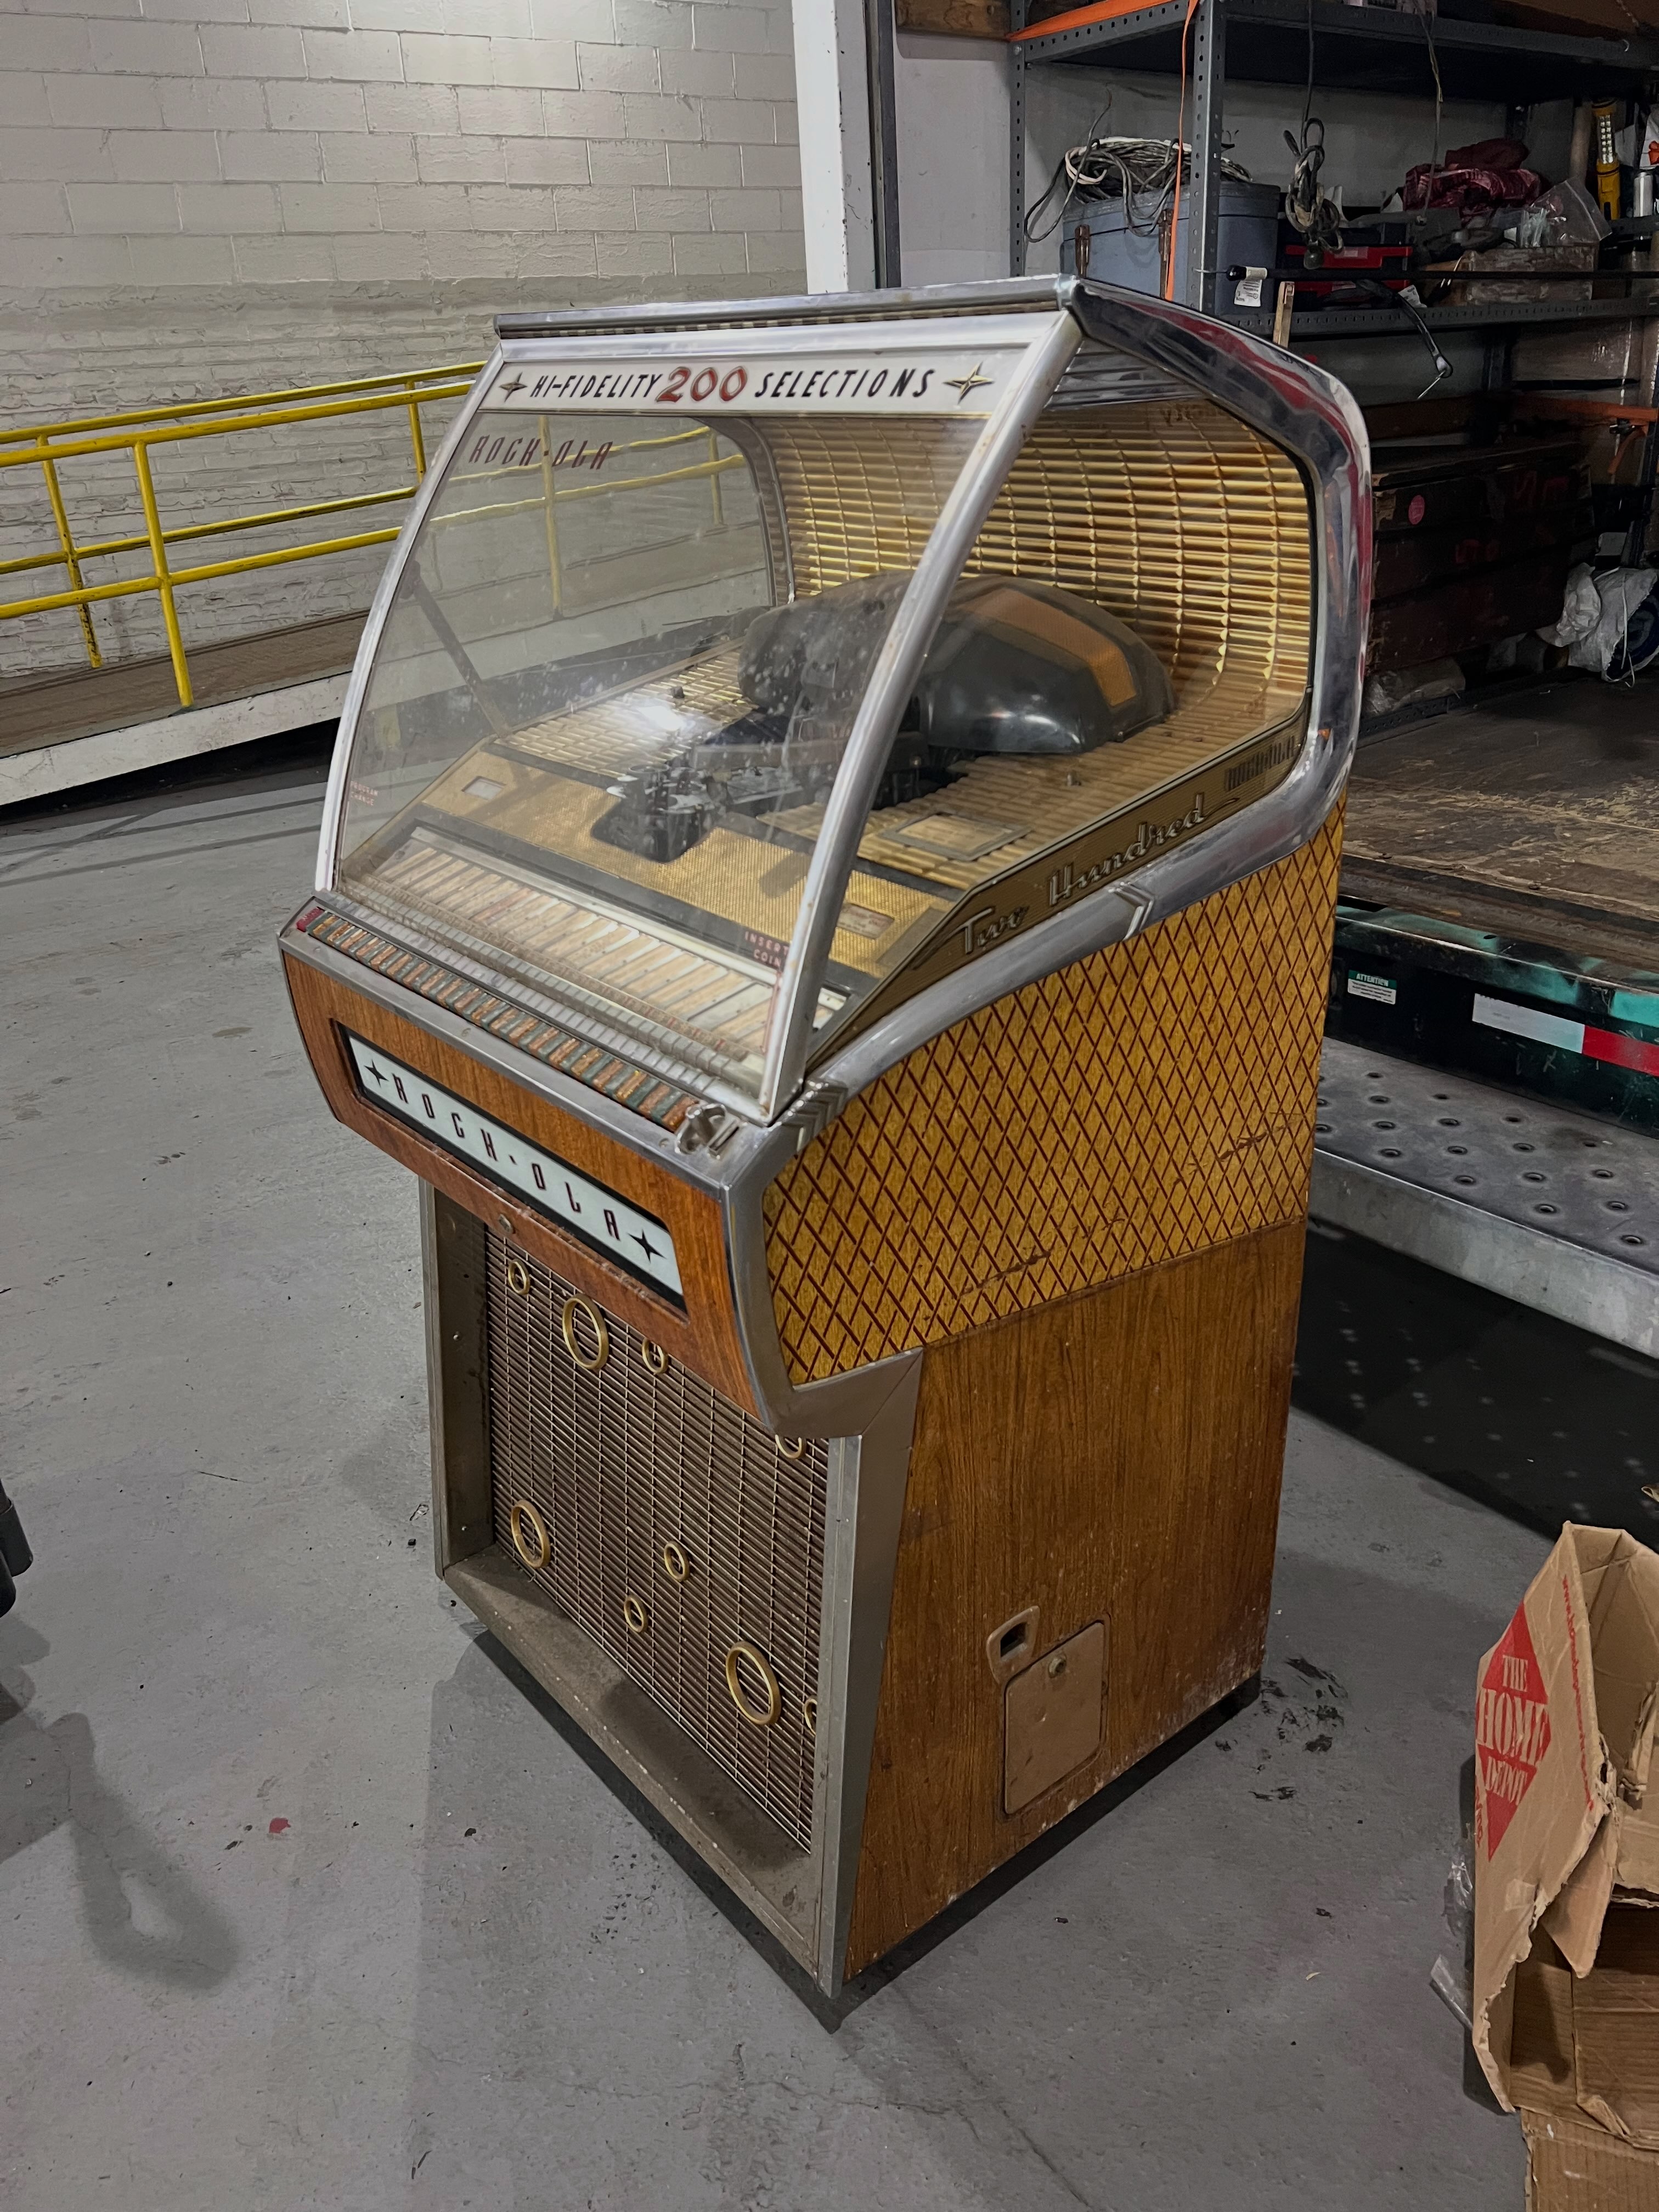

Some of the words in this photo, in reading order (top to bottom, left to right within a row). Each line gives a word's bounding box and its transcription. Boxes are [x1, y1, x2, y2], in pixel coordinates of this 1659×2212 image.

[530, 374, 663, 398] HI-FIDELITY
[654, 366, 748, 403] 200
[754, 368, 935, 398] SELECTIONS
[933, 905, 1030, 957] Two
[1049, 792, 1239, 906] Hundred
[744, 930, 789, 956] INSERT
[753, 949, 782, 969] COIN
[1356, 973, 1389, 987] ATTENTION
[1503, 1655, 1528, 1692] THE
[1477, 1688, 1550, 1767] HOME
[1485, 1755, 1528, 1806] DEPOT
